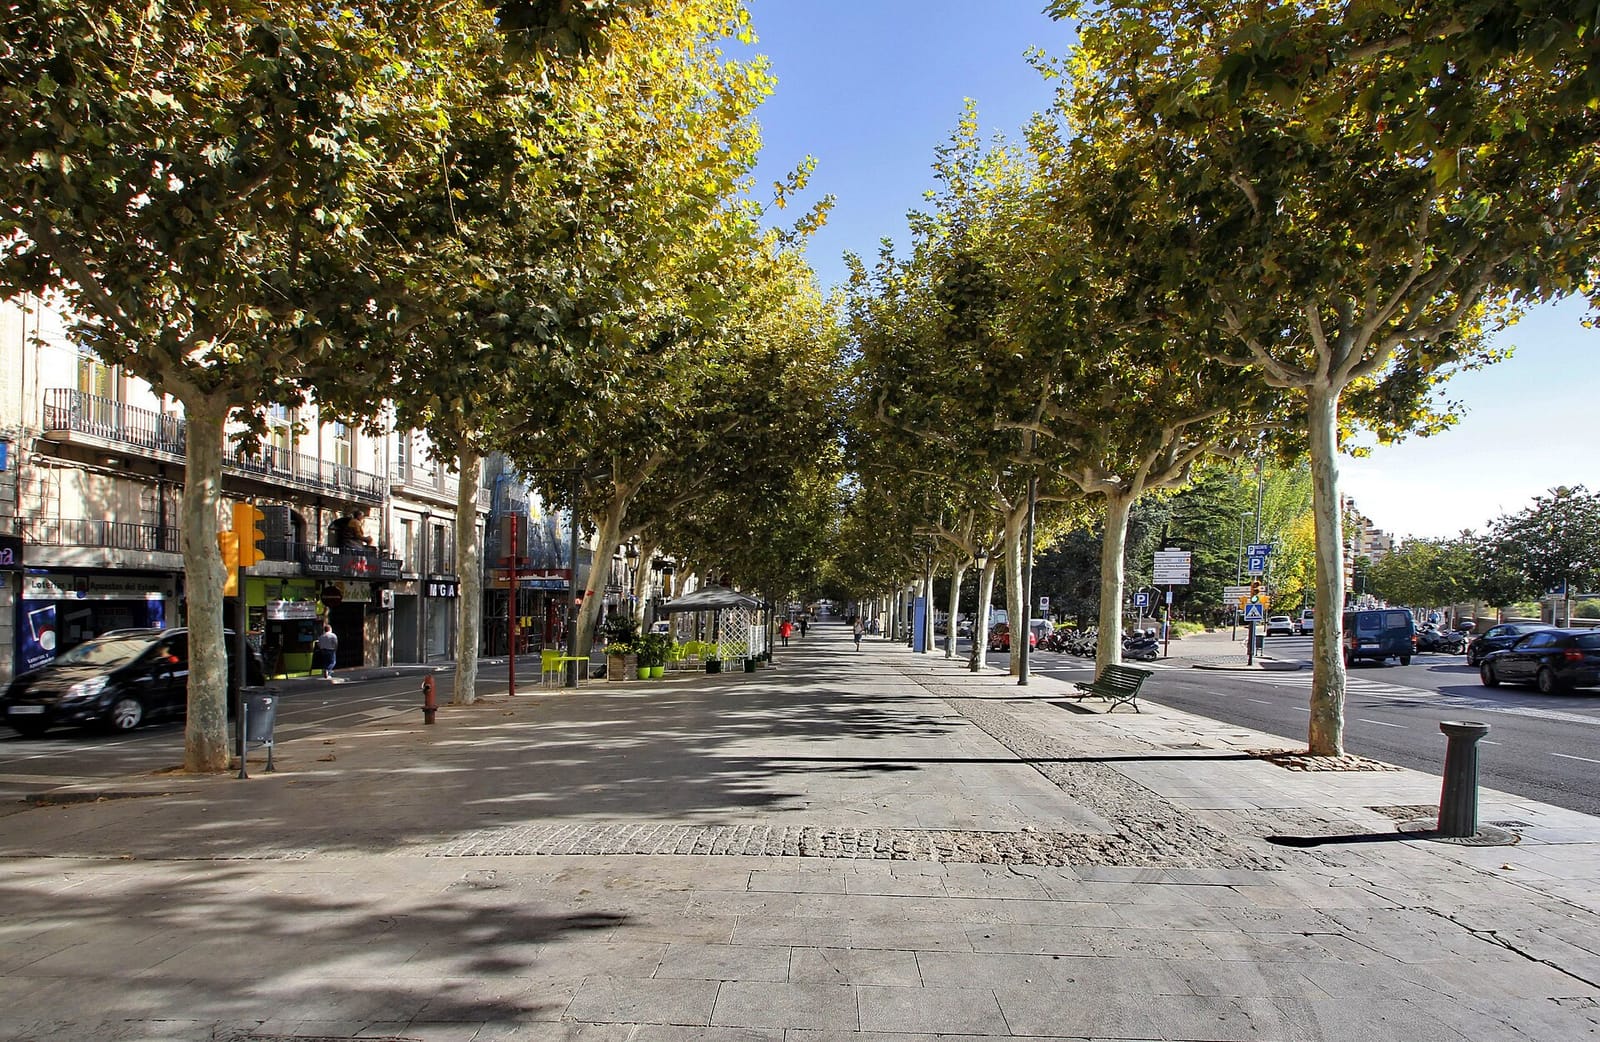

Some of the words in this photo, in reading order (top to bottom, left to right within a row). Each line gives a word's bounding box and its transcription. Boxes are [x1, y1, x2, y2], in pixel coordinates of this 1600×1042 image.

[1251, 558, 1261, 570] P
[429, 583, 455, 597] MGA
[1136, 594, 1146, 605] P
